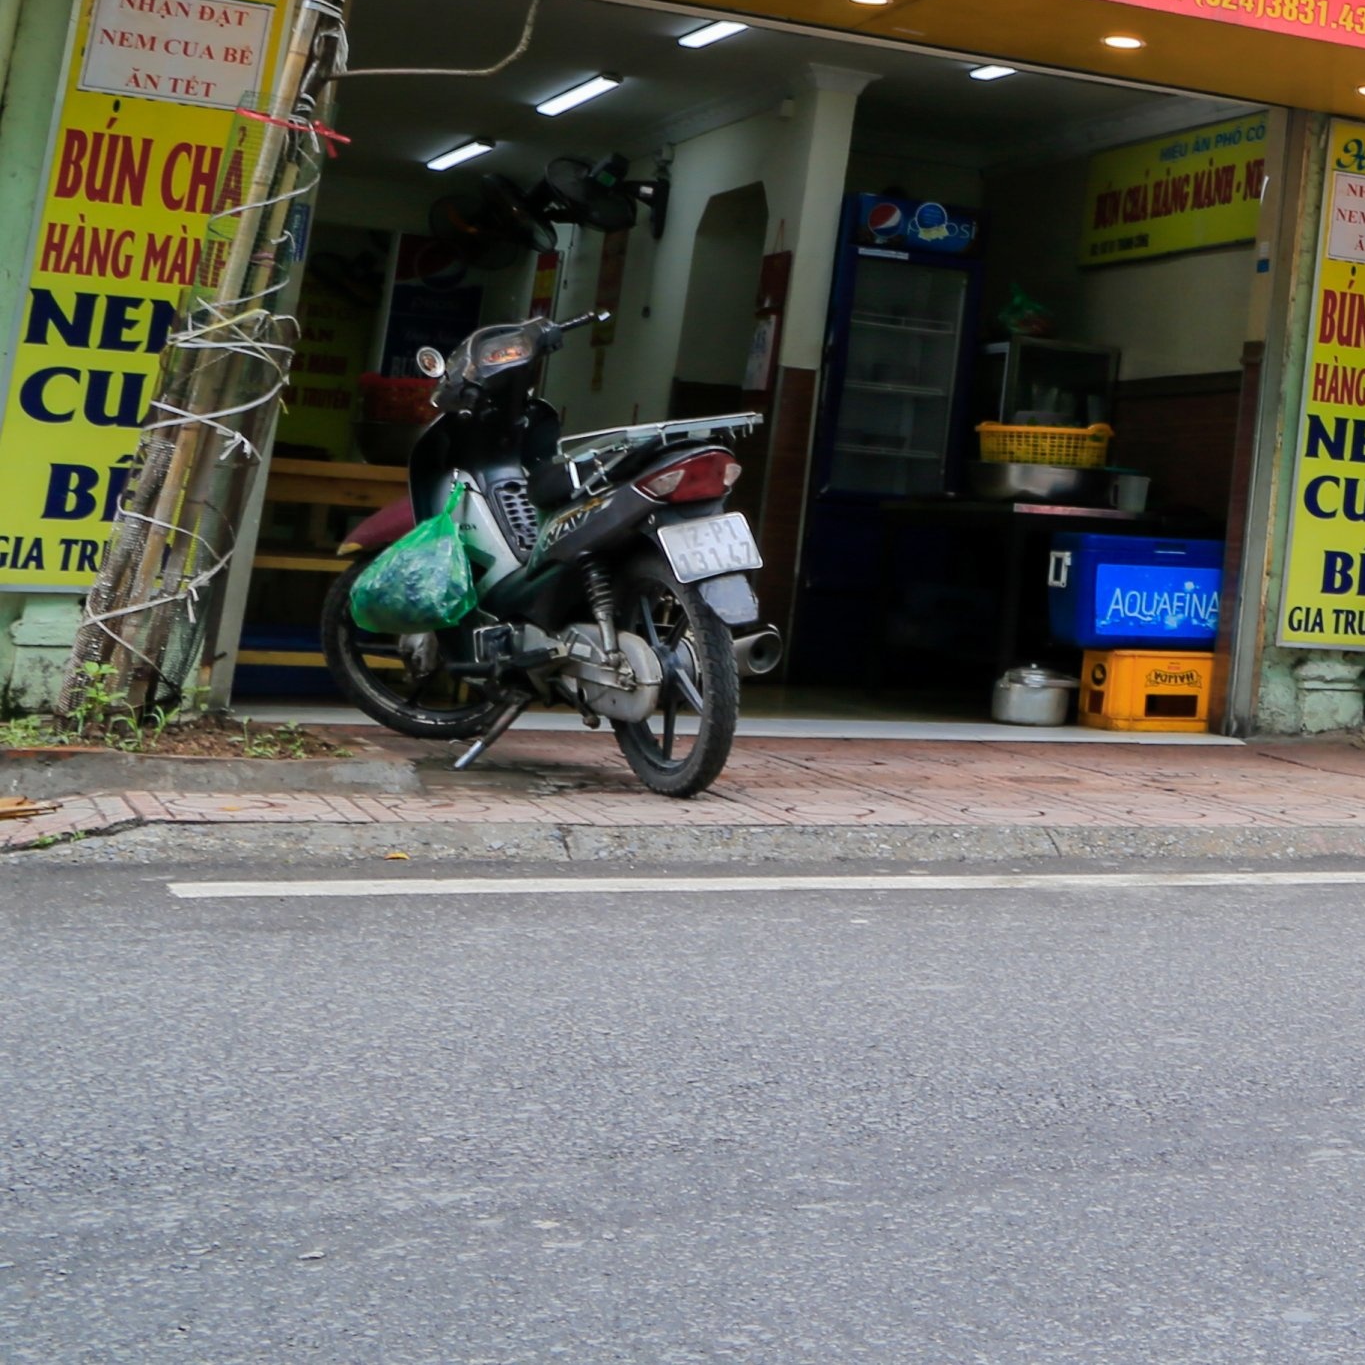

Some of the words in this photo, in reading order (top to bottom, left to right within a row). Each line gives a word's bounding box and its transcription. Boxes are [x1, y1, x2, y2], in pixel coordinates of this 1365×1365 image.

[199, 4, 251, 28] ĐẠT
[100, 28, 156, 53] NEM
[163, 38, 215, 60] CUA
[124, 67, 162, 91] ĂN
[167, 75, 217, 99] TẾT
[53, 117, 155, 207] BÚN
[158, 123, 246, 221] CHẢ
[38, 218, 138, 281] HÀNG
[1108, 585, 1221, 625] AQUAFINA
[1287, 605, 1326, 635] GIA
